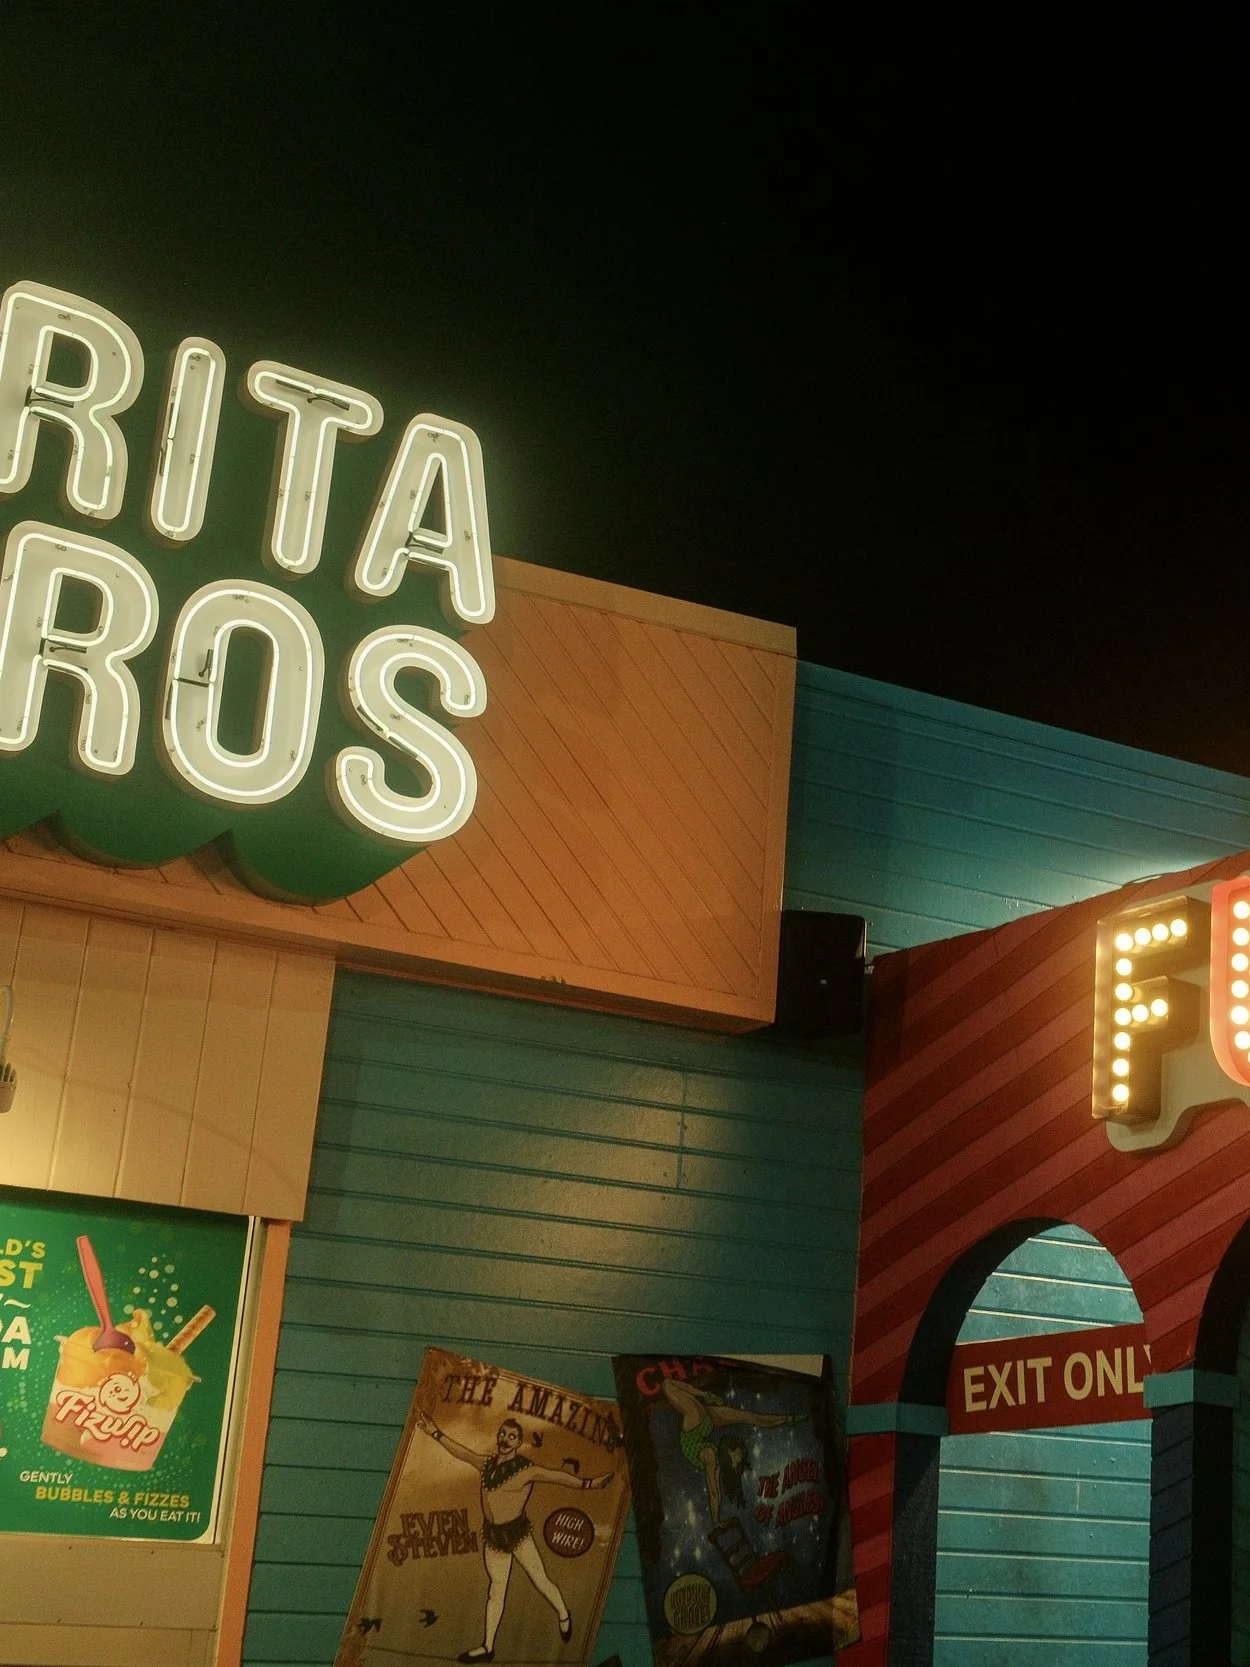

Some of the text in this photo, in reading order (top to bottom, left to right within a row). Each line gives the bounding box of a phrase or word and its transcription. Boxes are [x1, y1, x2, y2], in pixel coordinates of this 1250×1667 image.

[442, 1373, 498, 1406] THE
[963, 1356, 1053, 1413] EXIT
[19, 1470, 73, 1485] GENTLY
[35, 1485, 191, 1509] BUBBLES & FIZZES
[109, 1507, 201, 1524] AS YOU EAT IT!
[400, 1508, 470, 1539] EVEN
[554, 1513, 585, 1532] HIGH
[386, 1531, 479, 1567] STEVEN
[551, 1531, 585, 1549] WIRE!
